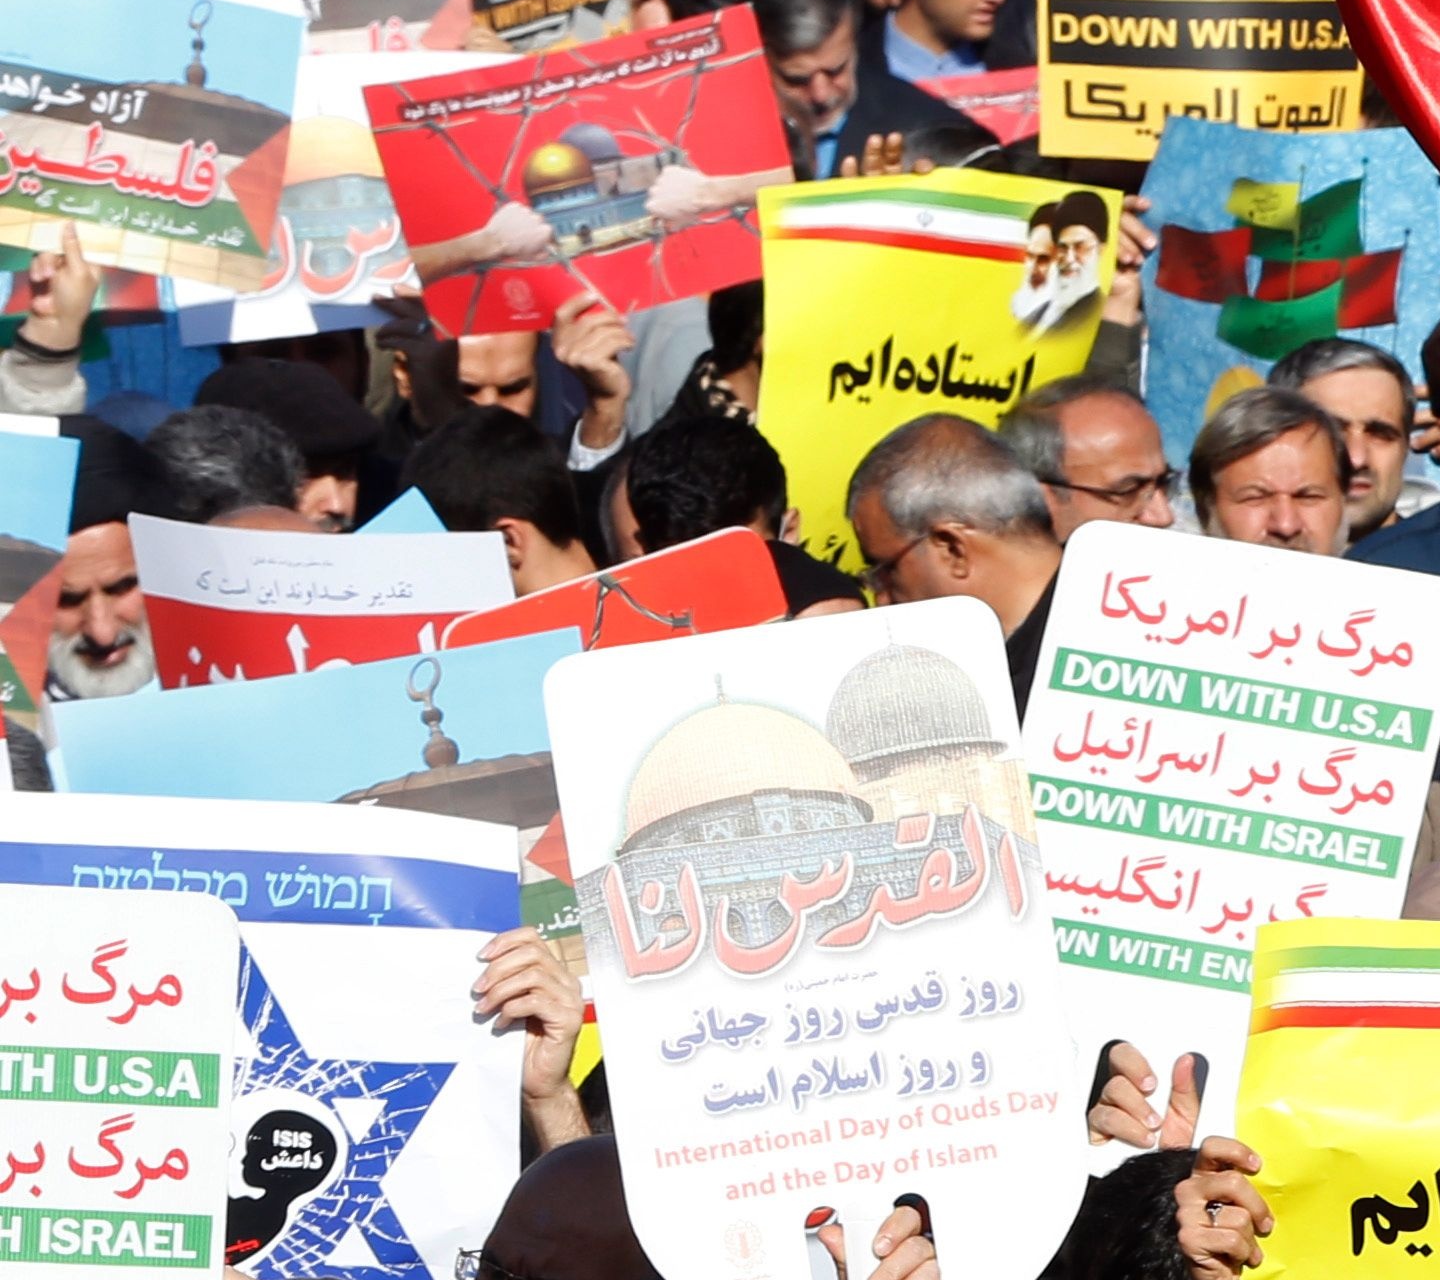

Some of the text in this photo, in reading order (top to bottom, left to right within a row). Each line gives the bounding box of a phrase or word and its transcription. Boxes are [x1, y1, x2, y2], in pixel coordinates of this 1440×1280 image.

[1052, 15, 1284, 48] DOWN WITH
[97, 90, 148, 118] آزاد
[1031, 781, 1388, 870] DOWN WITH ISRAEL
[660, 969, 1019, 1061] روز قدس روز جهانی
[72, 1053, 202, 1101] U.S.A
[272, 1129, 312, 1150] ISIS
[655, 1091, 1060, 1169] International Day of Quds Day
[259, 1148, 323, 1173] داعش
[725, 1140, 998, 1202] and the Day of Islam
[38, 1218, 197, 1262] ISRAEL
